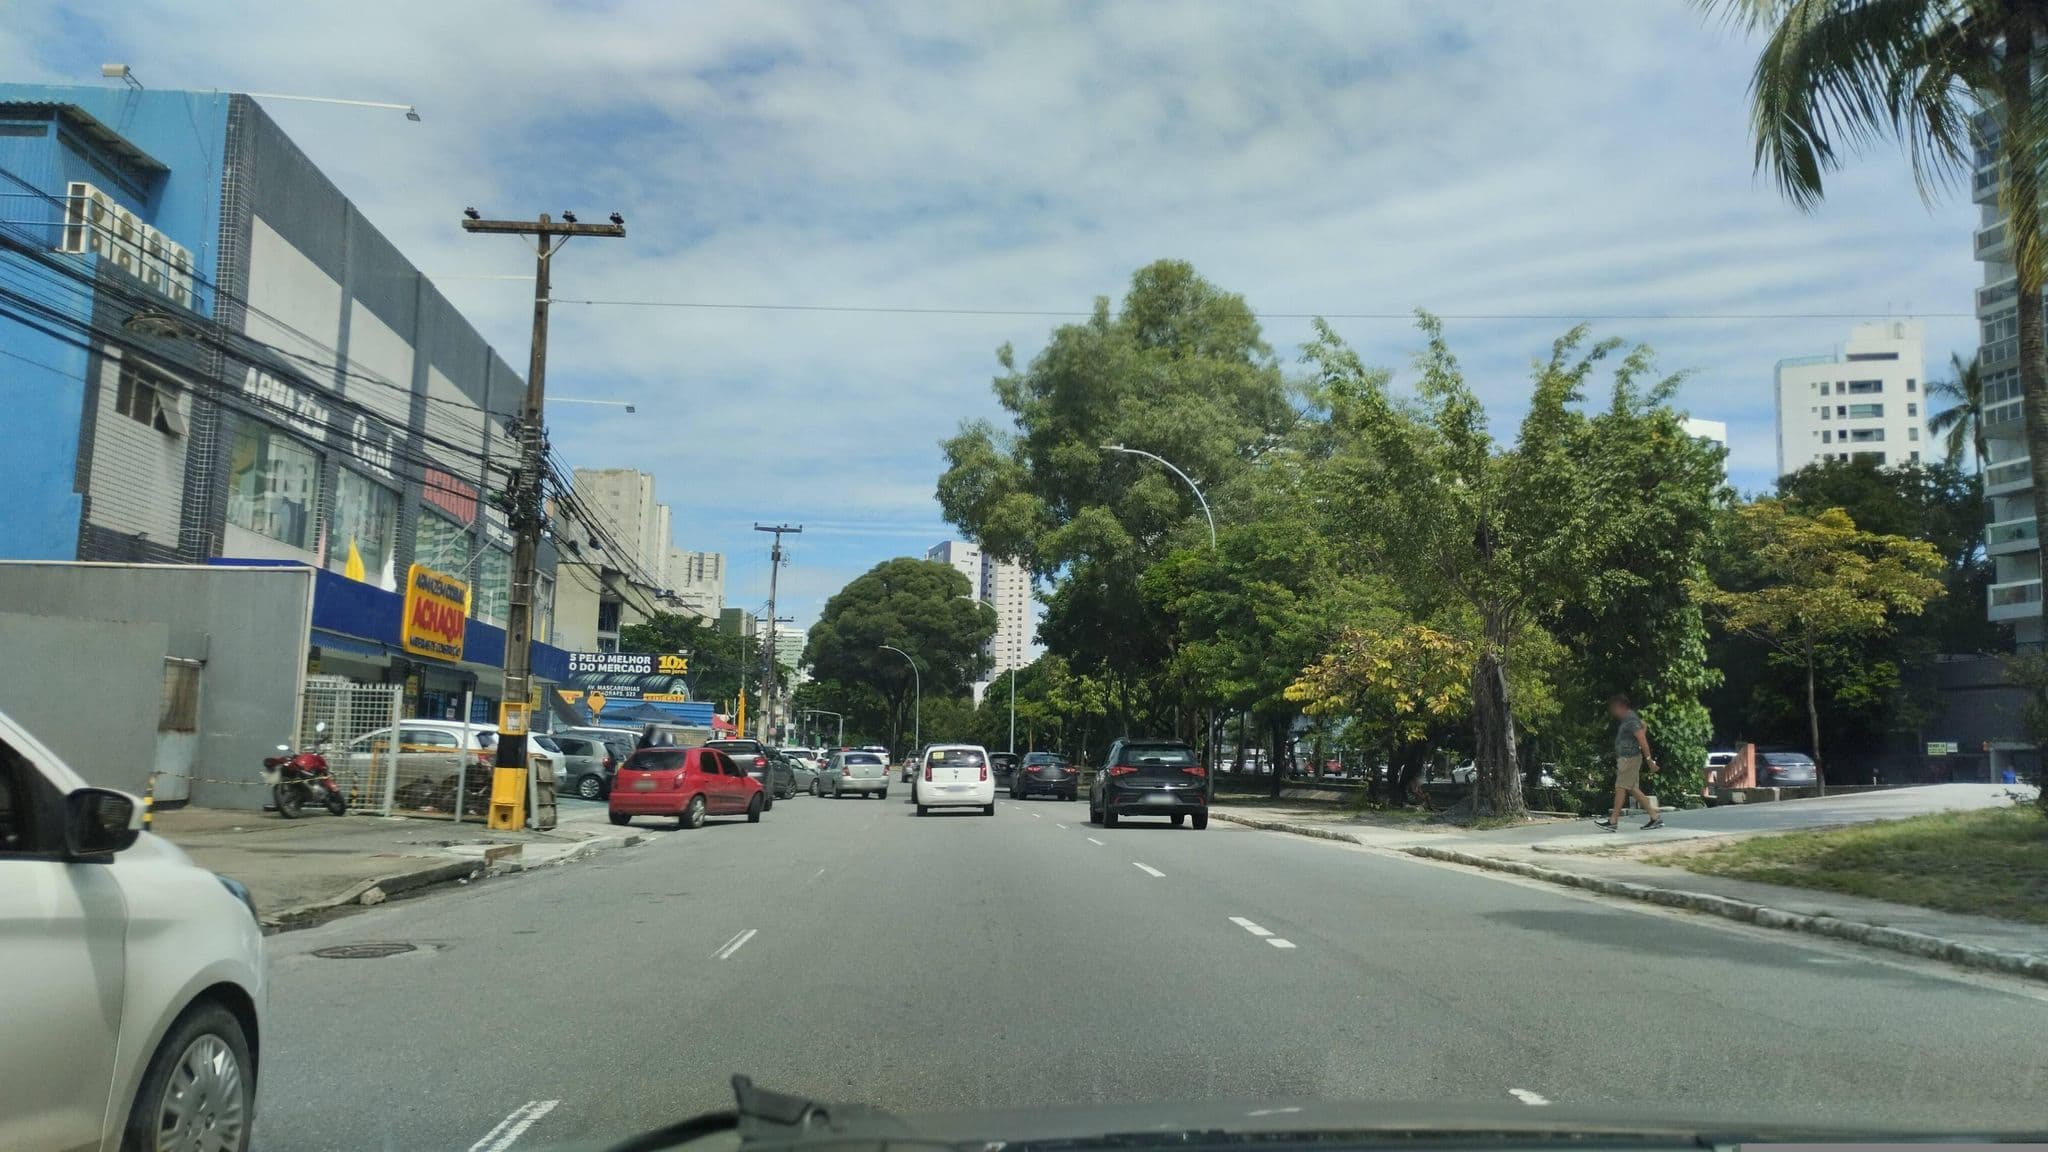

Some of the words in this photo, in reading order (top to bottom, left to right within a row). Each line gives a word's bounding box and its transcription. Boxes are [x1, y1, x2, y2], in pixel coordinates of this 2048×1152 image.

[241, 367, 329, 441] ARMAZÉM
[579, 654, 605, 663] PELO
[607, 655, 651, 665] MELHOR
[579, 662, 596, 671] DO
[597, 663, 651, 674] MERCADO
